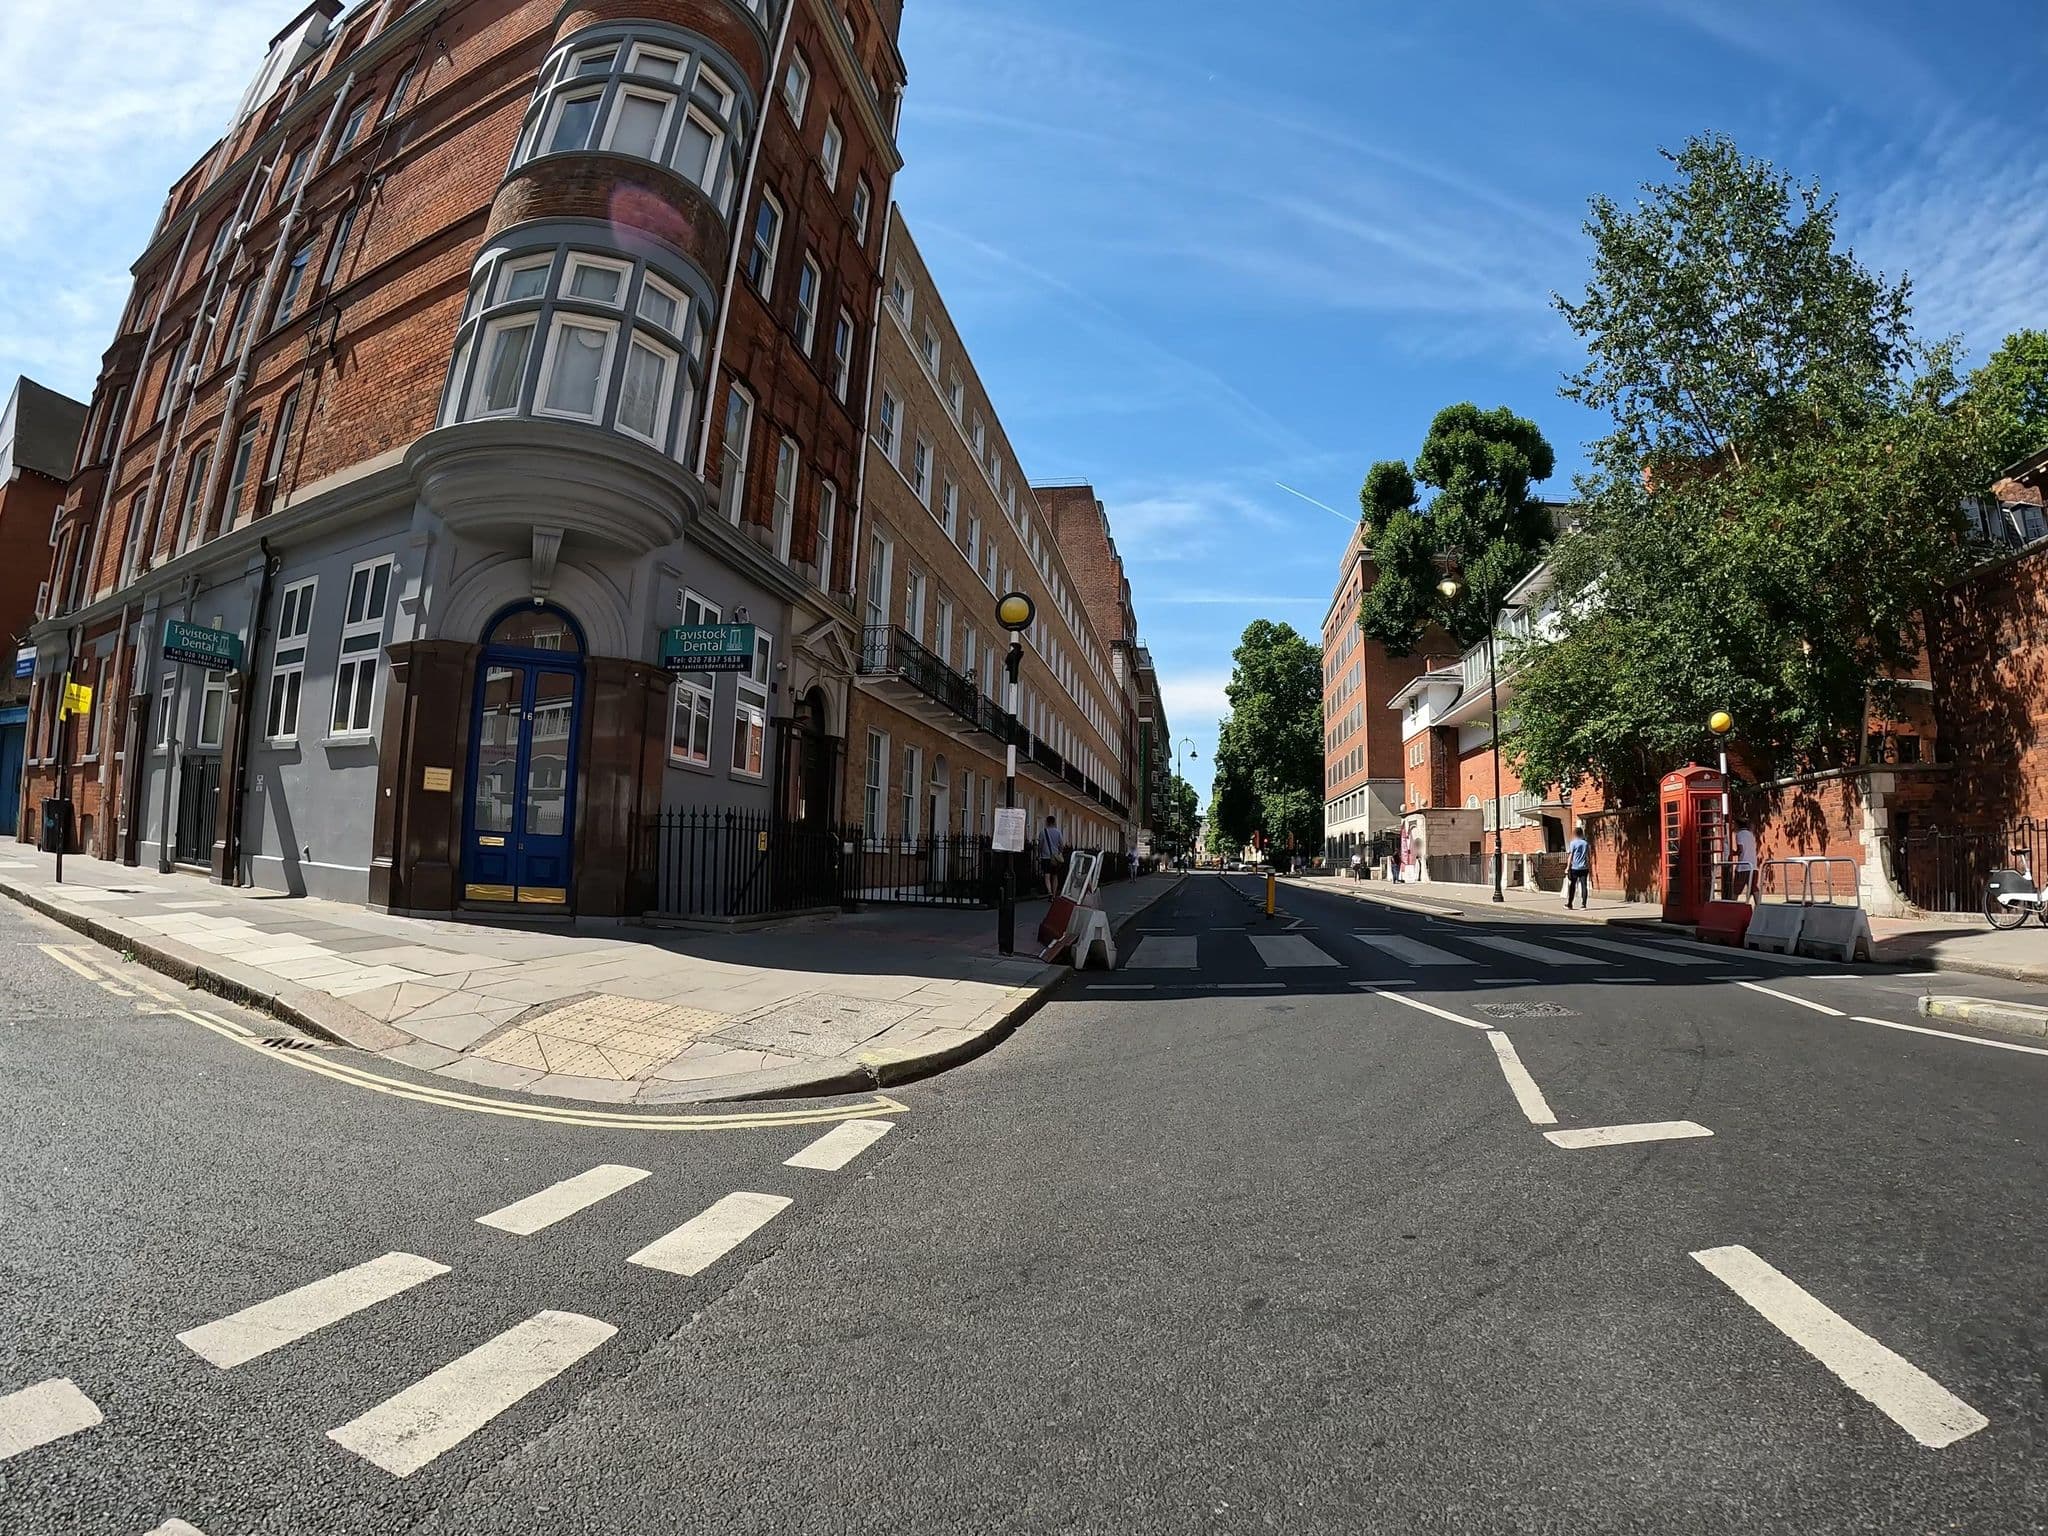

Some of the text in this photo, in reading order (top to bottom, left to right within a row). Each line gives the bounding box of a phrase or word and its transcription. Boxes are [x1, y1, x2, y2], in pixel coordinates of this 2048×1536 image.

[174, 624, 218, 642] Tavistock
[674, 628, 727, 640] Tavistock
[181, 636, 214, 652] Dental
[683, 640, 722, 652] Dental
[673, 656, 686, 664] Tel:
[523, 711, 533, 720] 16
